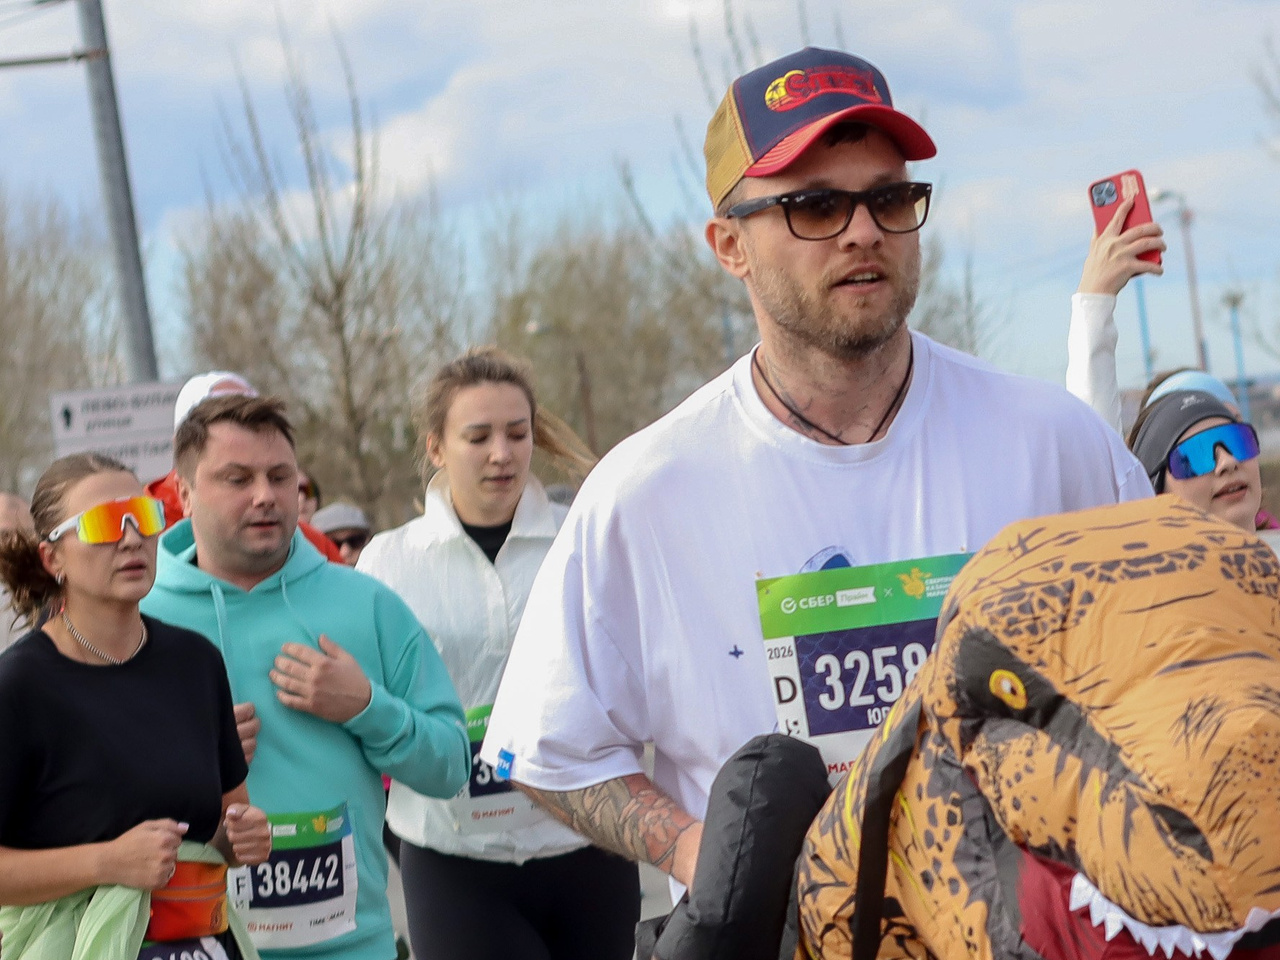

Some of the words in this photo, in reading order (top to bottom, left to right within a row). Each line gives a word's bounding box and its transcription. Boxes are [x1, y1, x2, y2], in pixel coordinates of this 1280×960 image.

[799, 594, 834, 609] СБЕР
[767, 646, 794, 660] 2026
[814, 641, 937, 711] 3258
[774, 677, 798, 704] D
[235, 876, 246, 895] F
[256, 853, 339, 898] 38442
